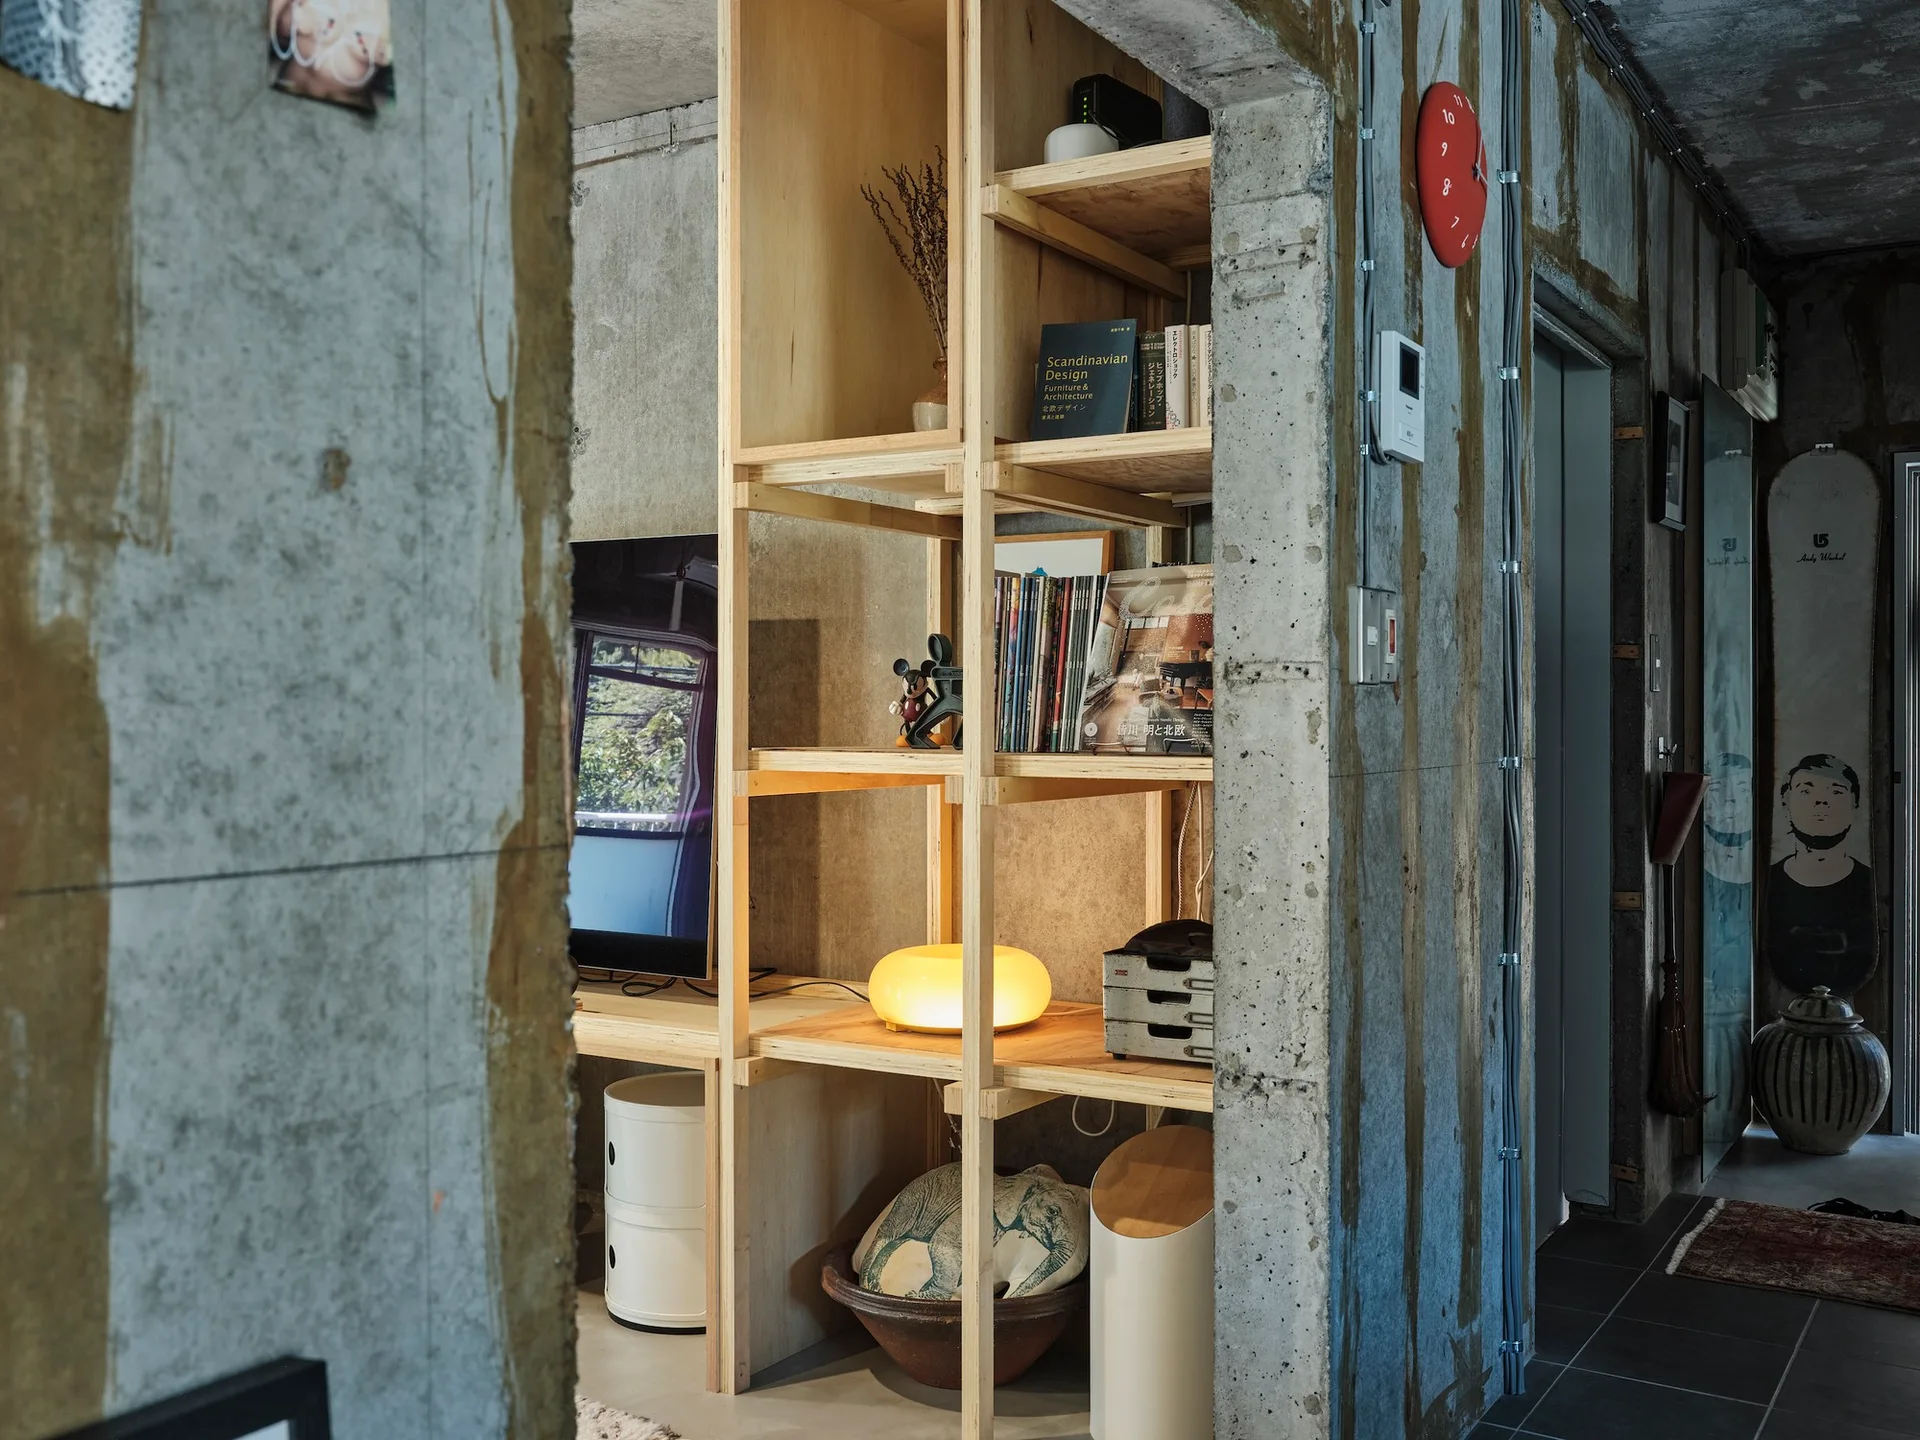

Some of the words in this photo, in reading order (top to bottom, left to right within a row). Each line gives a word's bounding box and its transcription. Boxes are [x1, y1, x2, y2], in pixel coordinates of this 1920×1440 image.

[1442, 108, 1455, 125] 10
[1441, 141, 1448, 157] 9
[1442, 177, 1451, 196] 8
[1450, 215, 1460, 228] 7
[1047, 354, 1128, 368] Scandinavian
[1045, 369, 1088, 382] Design
[1044, 384, 1081, 392] Furniture
[1082, 383, 1089, 391] &
[1044, 393, 1093, 401] Architecture
[1796, 553, 1817, 563] Andy
